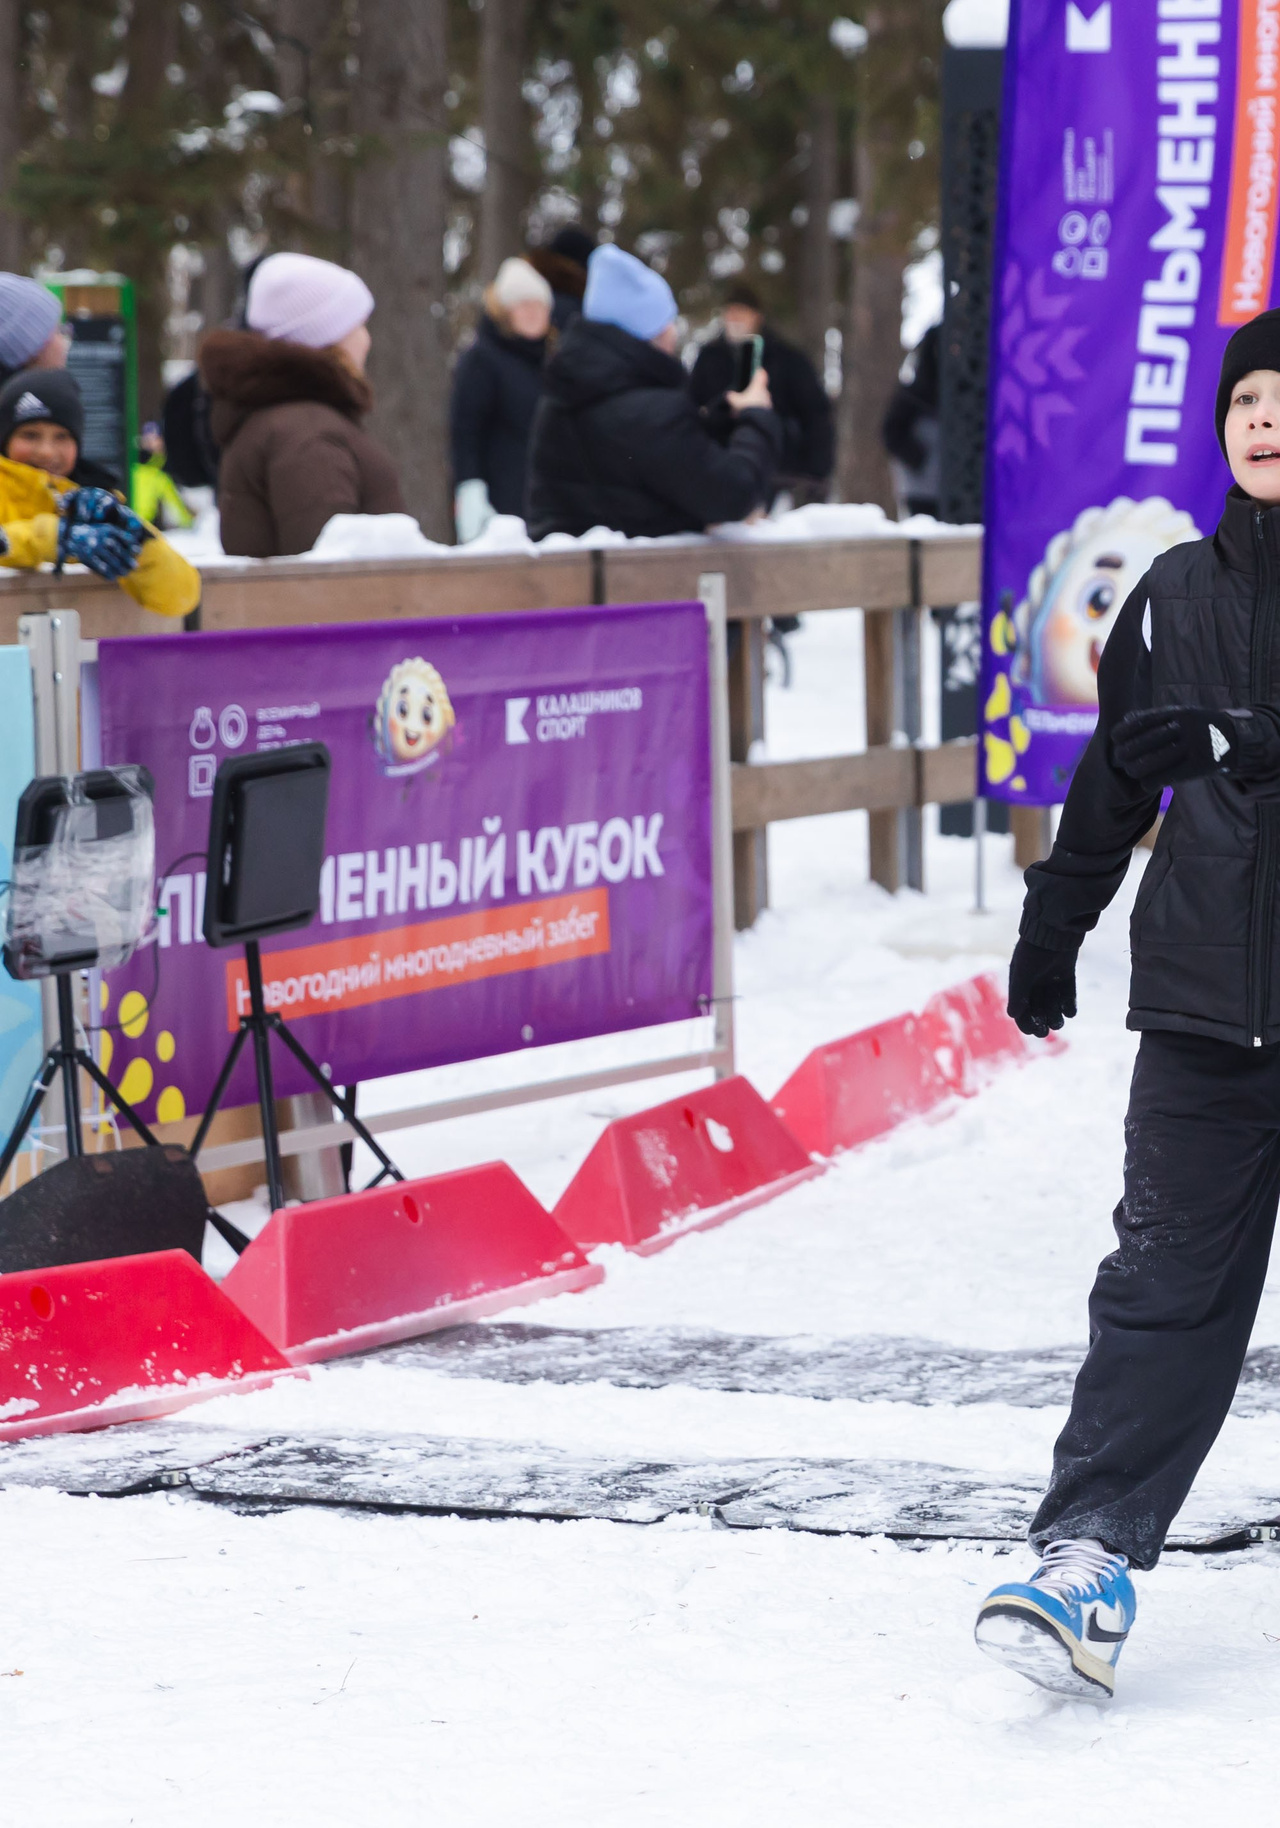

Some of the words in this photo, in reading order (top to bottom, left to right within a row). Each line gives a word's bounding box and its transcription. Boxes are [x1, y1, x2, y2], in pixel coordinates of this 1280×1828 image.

[1125, 0, 1222, 465] ПЕЛЬМЕНН
[1233, 95, 1277, 312] Новогодний
[536, 687, 643, 718] КАЛАШНИКОВ
[536, 715, 587, 742] СПОРТ
[516, 812, 665, 896] КУБОК
[236, 952, 381, 1014] Нвогодний
[384, 916, 544, 982] многодневный
[546, 906, 599, 948] забег
